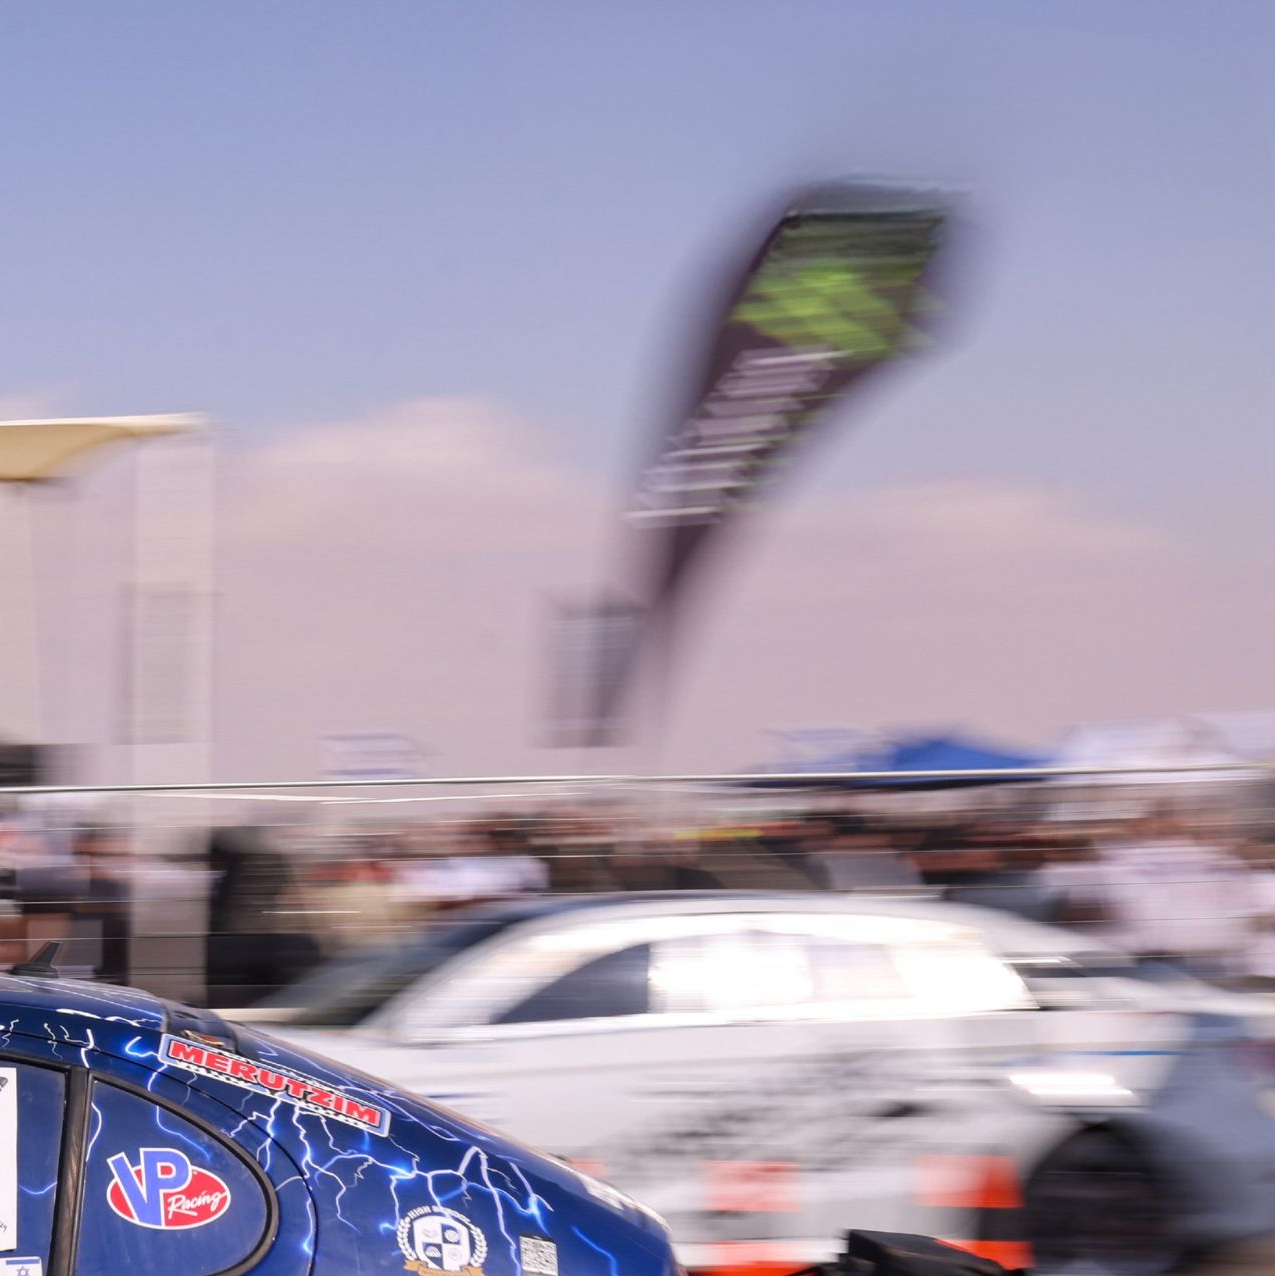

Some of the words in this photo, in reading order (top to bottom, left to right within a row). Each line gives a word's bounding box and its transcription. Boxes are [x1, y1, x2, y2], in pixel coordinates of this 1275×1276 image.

[168, 1039, 381, 1127] MERUTZIM
[106, 1148, 192, 1229] VP
[167, 1191, 226, 1219] Racing
